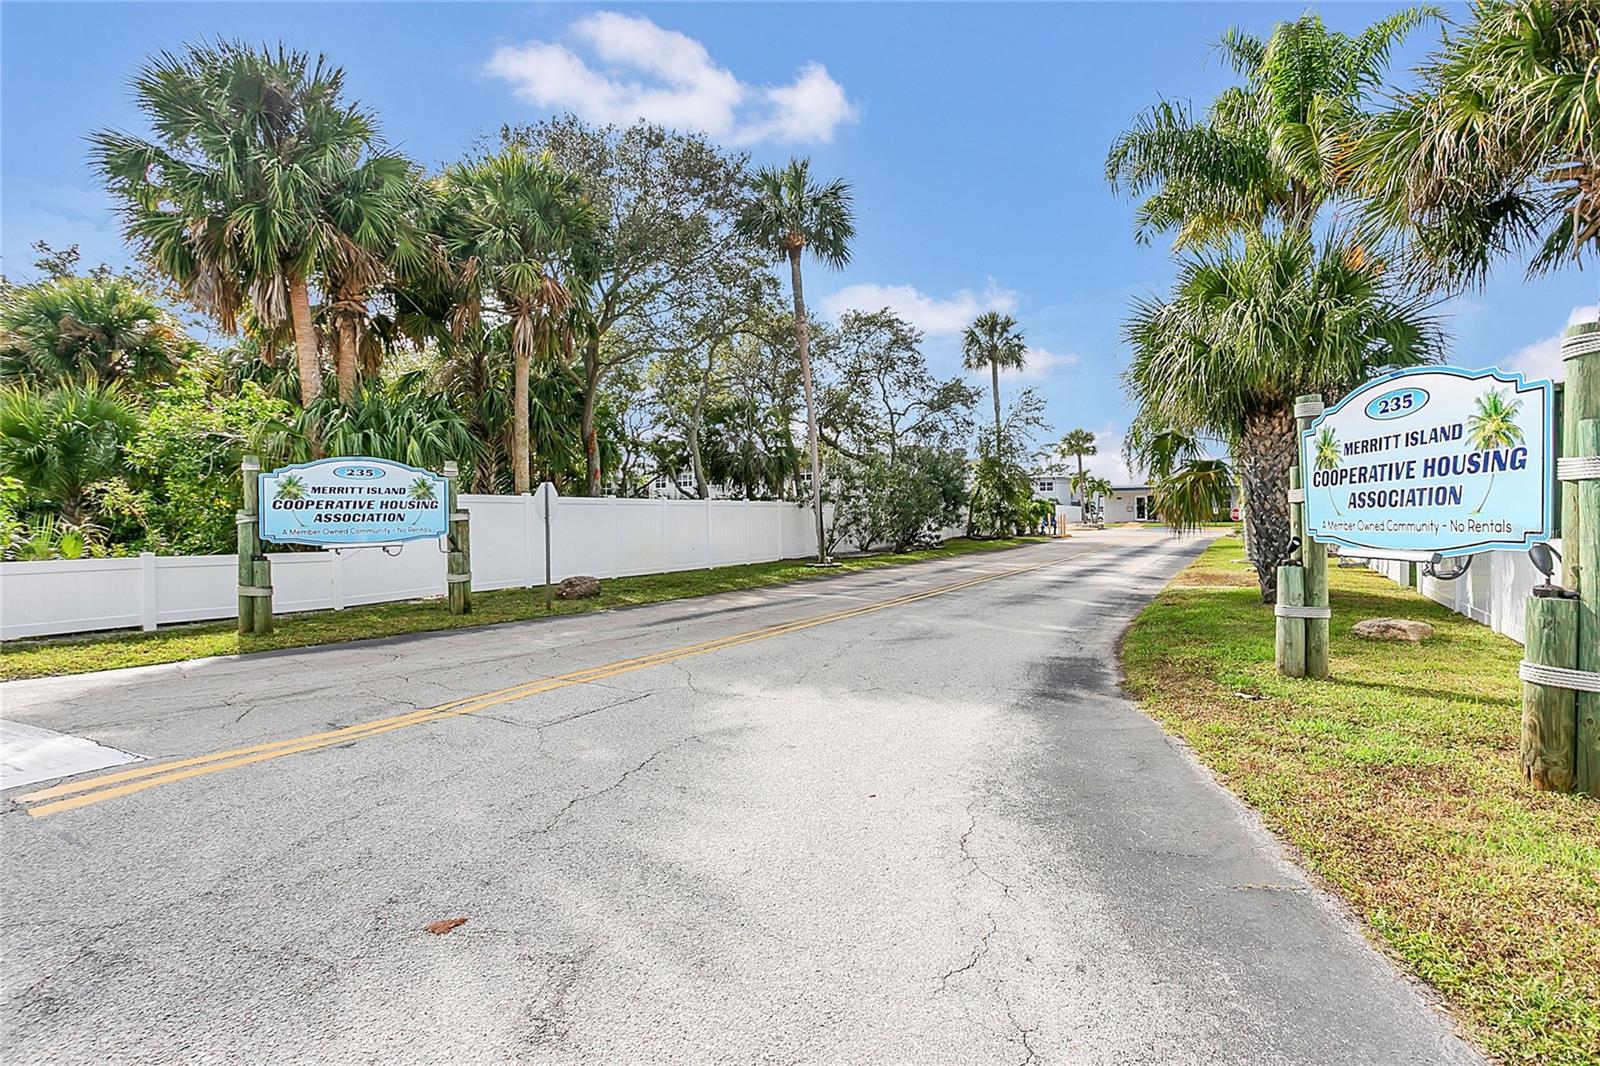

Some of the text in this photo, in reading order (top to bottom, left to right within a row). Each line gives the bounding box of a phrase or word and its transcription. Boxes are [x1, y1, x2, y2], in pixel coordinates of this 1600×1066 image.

[1378, 394, 1413, 415] 235
[1343, 423, 1464, 456] MERRITT ISLAND
[345, 468, 374, 477] 235
[1313, 447, 1528, 488] COOPERATIVE HOUSING
[311, 486, 406, 495] MERRITT ISLAND
[1348, 485, 1463, 509] ASSOCIATION
[272, 500, 439, 510] COOPERATIVE HOUSING
[313, 512, 406, 523] ASSOCIATION
[290, 528, 321, 536] Member
[322, 528, 349, 536] Owned
[350, 527, 390, 537] Community
[407, 526, 432, 534] Rentals
[1328, 521, 1356, 531] Member
[1357, 520, 1385, 532] Owned
[1386, 519, 1440, 536] Community
[1450, 520, 1465, 532] No
[1467, 518, 1513, 533] Rentals
